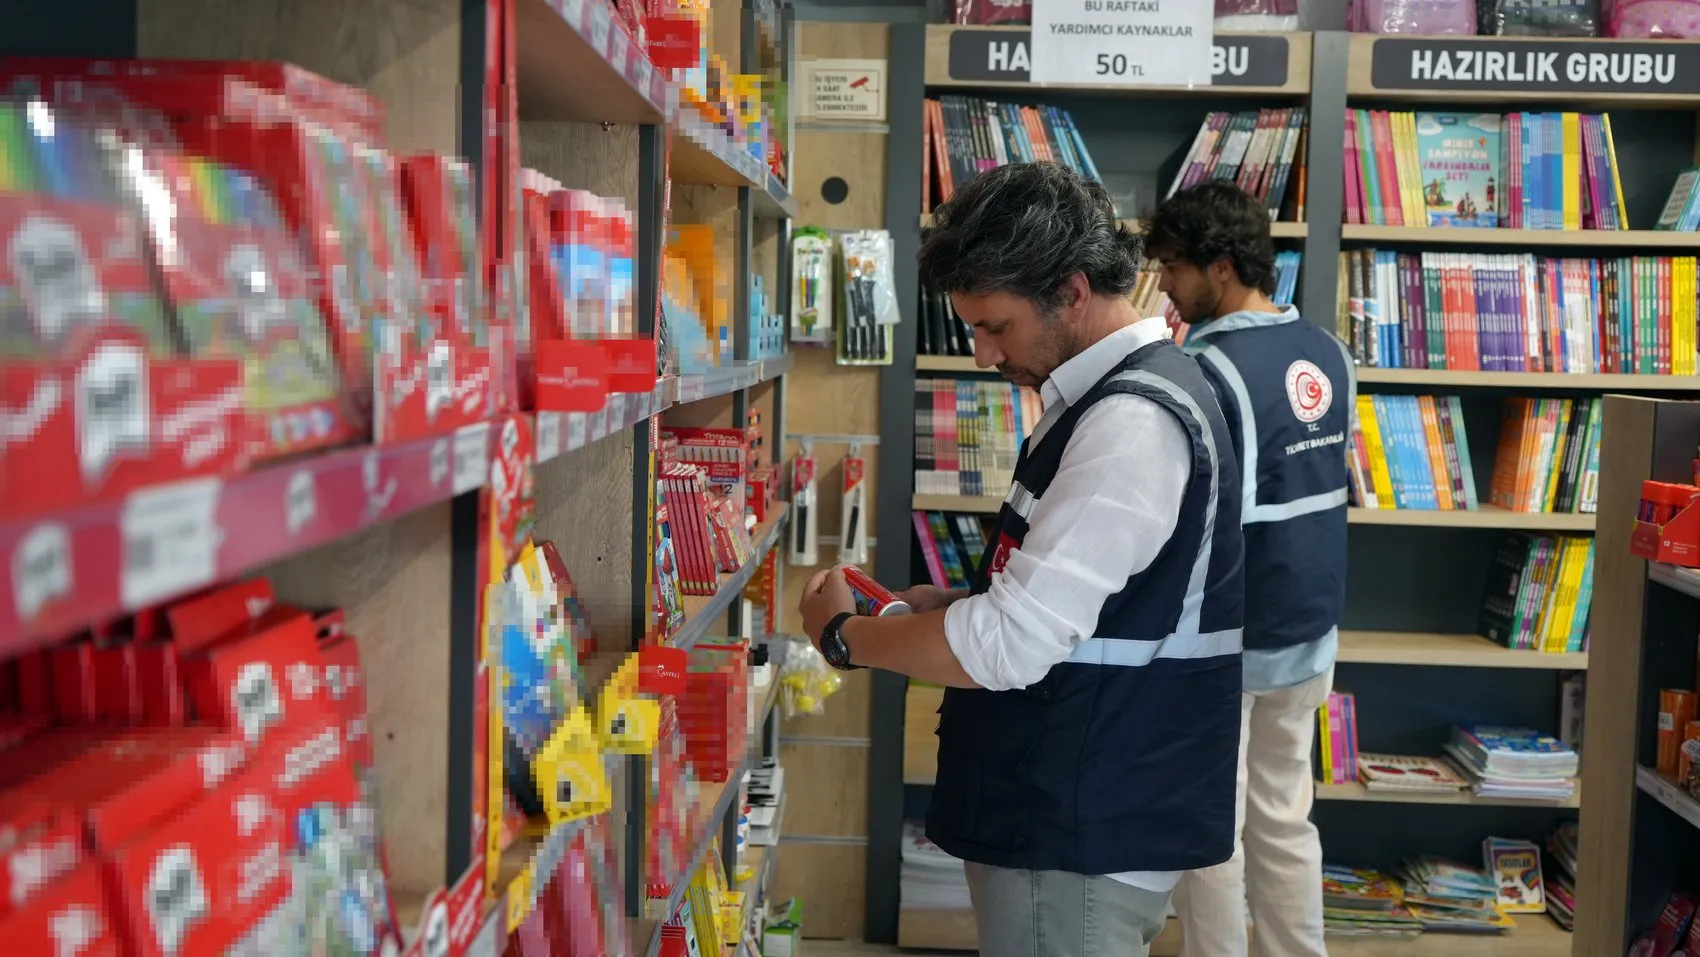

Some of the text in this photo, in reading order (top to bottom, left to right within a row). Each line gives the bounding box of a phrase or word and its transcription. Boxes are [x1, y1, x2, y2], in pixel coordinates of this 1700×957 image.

[1084, 0, 1159, 12] BU RAFTAKİ
[1049, 24, 1193, 37] YARDIMCI KAYNAKLAR
[1096, 53, 1144, 76] 50 TL
[1411, 50, 1676, 84] HAZIRLIK GRUBU
